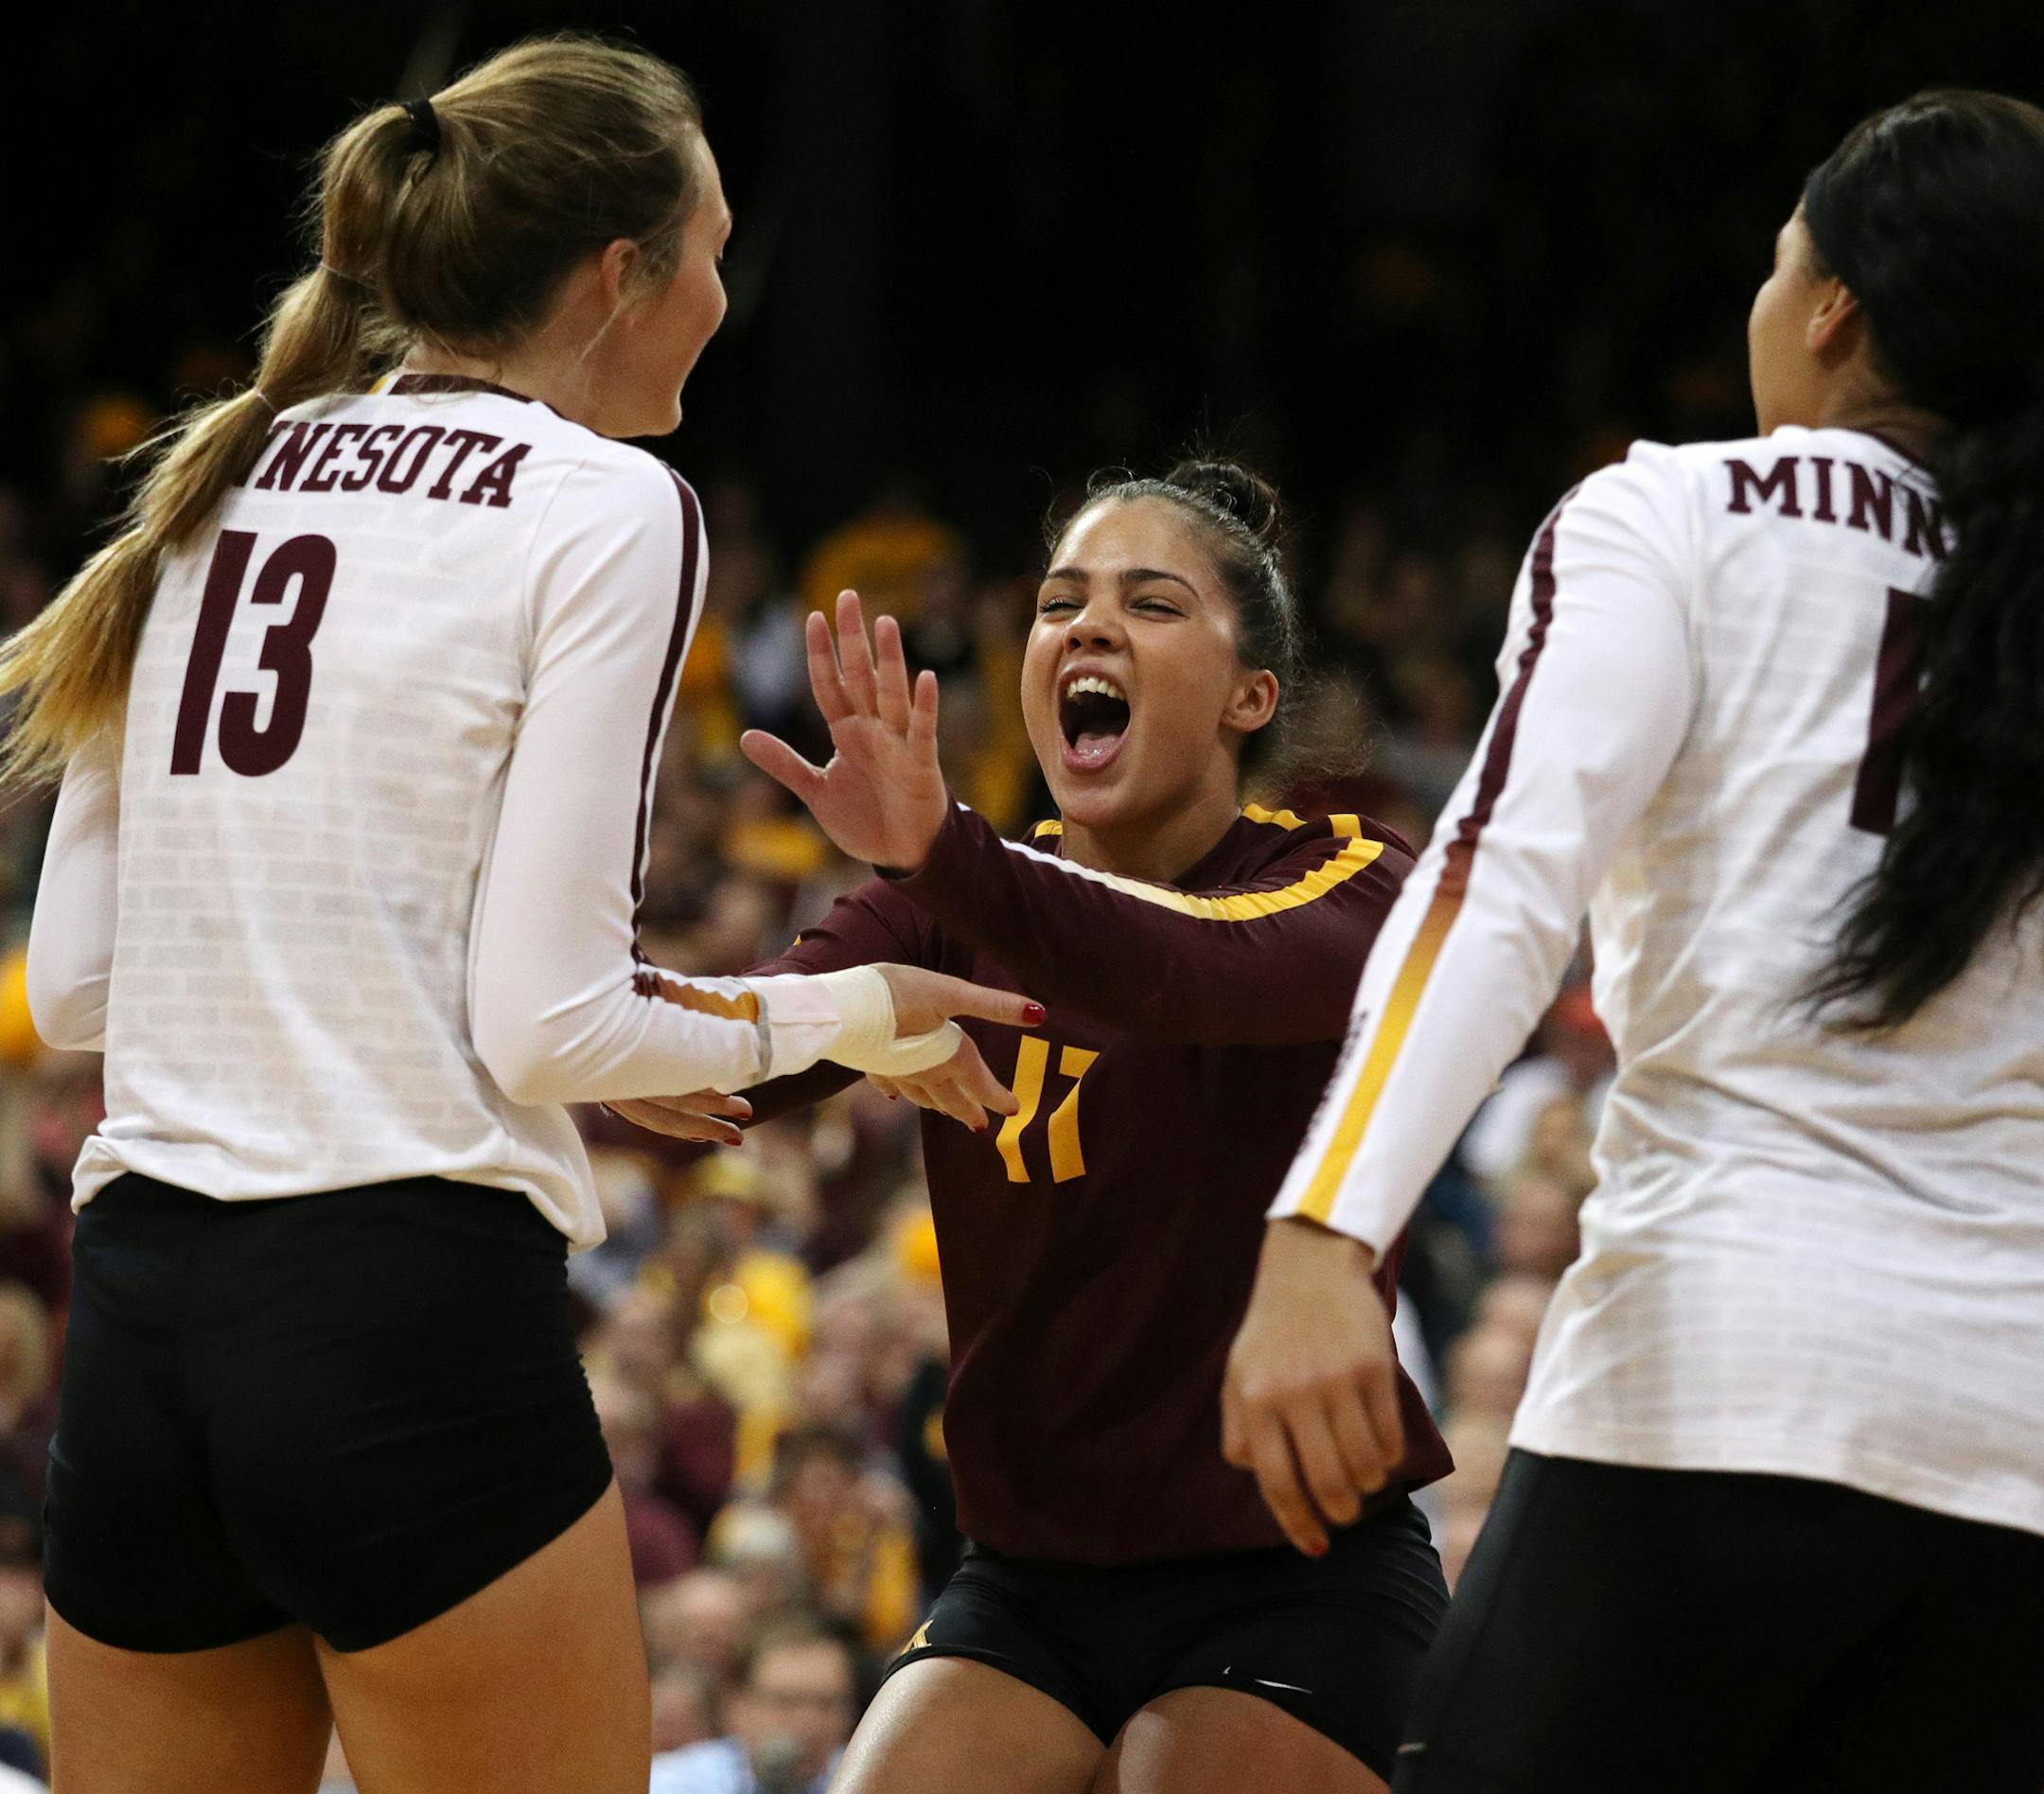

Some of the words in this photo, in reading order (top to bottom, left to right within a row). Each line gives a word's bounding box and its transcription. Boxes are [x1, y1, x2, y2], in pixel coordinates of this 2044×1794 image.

[234, 420, 533, 508] NESOTA
[170, 529, 337, 778] 13
[996, 1034, 1100, 1184] 17
